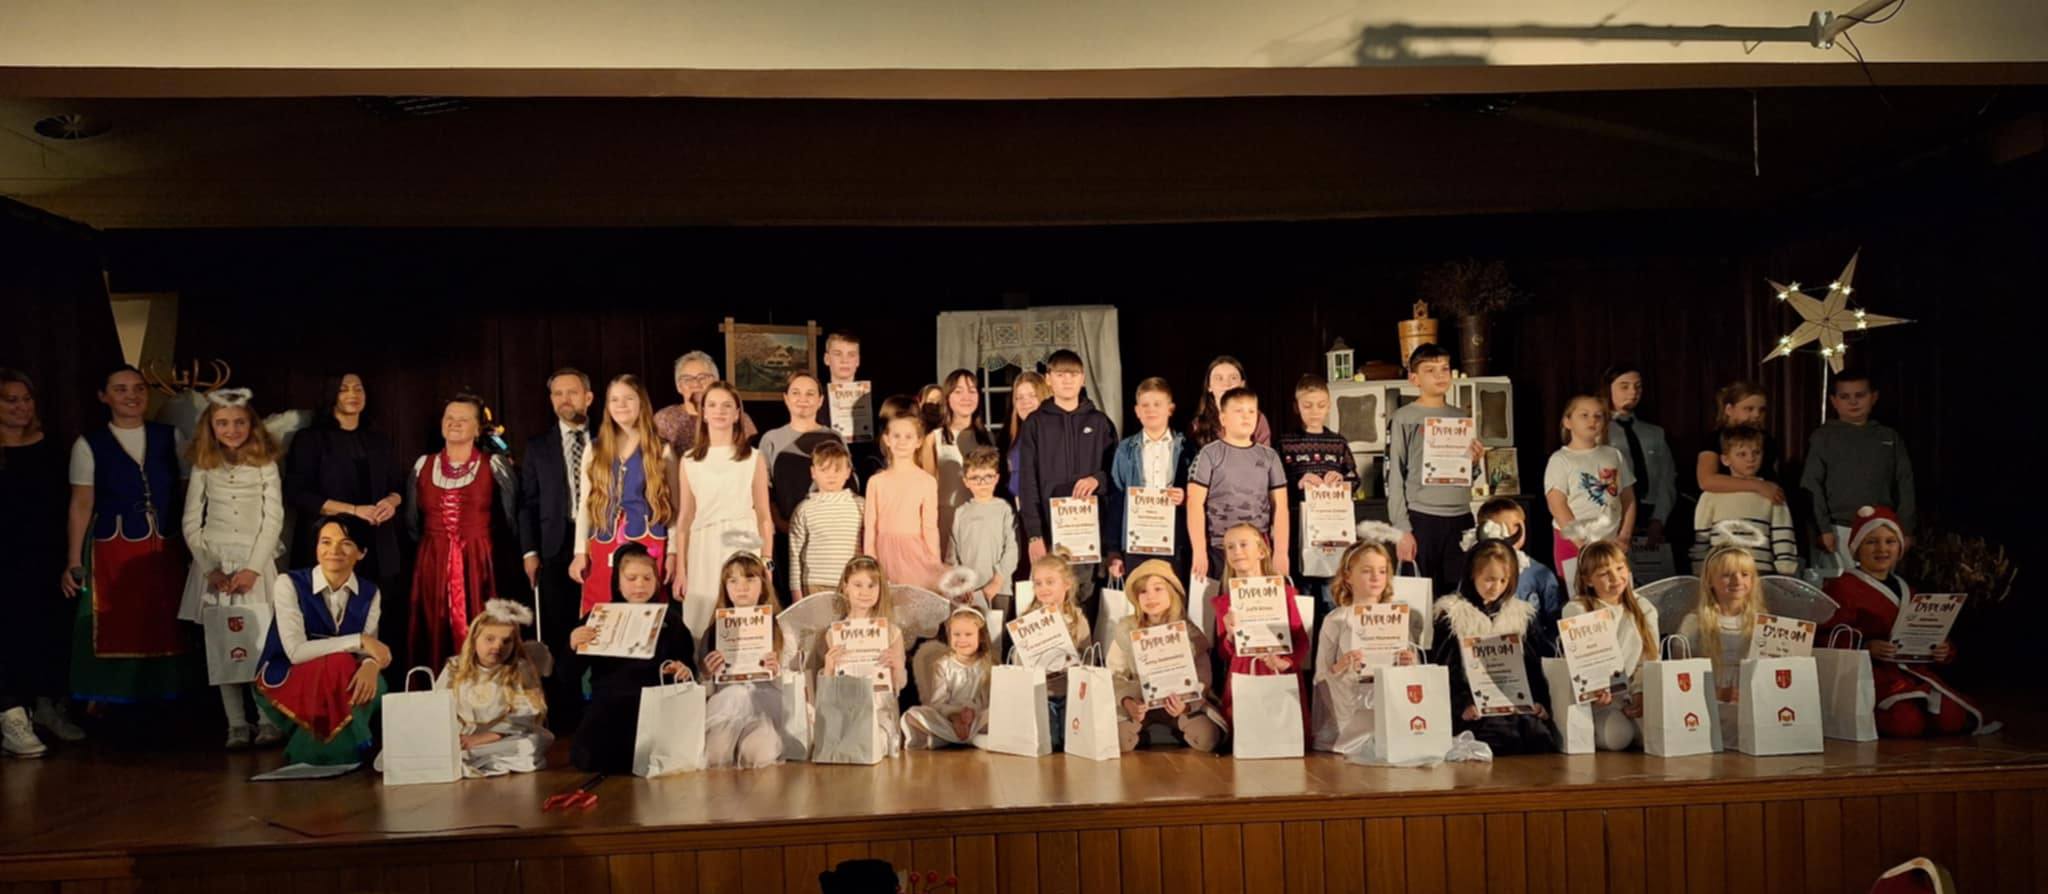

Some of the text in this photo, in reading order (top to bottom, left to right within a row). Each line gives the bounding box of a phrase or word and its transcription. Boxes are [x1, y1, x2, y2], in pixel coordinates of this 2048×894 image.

[1431, 426, 1467, 436] DYPLOM
[1134, 495, 1170, 505] DYPLOM
[1311, 490, 1345, 499] DYPLOM
[1057, 505, 1092, 516] DYPLOM
[1237, 586, 1278, 599] DYPLOM
[1914, 603, 1956, 612] DYPLOM
[724, 616, 764, 629] DYPLOM
[1018, 614, 1055, 638] DYPLOM
[1361, 613, 1402, 626] DYPLOM
[841, 627, 880, 640] DYPLOM
[1569, 620, 1609, 640] DYPLOM
[1763, 624, 1807, 643] DYPLOM
[1140, 632, 1180, 651] DYPLOM
[1472, 643, 1514, 657] DYPLOM
